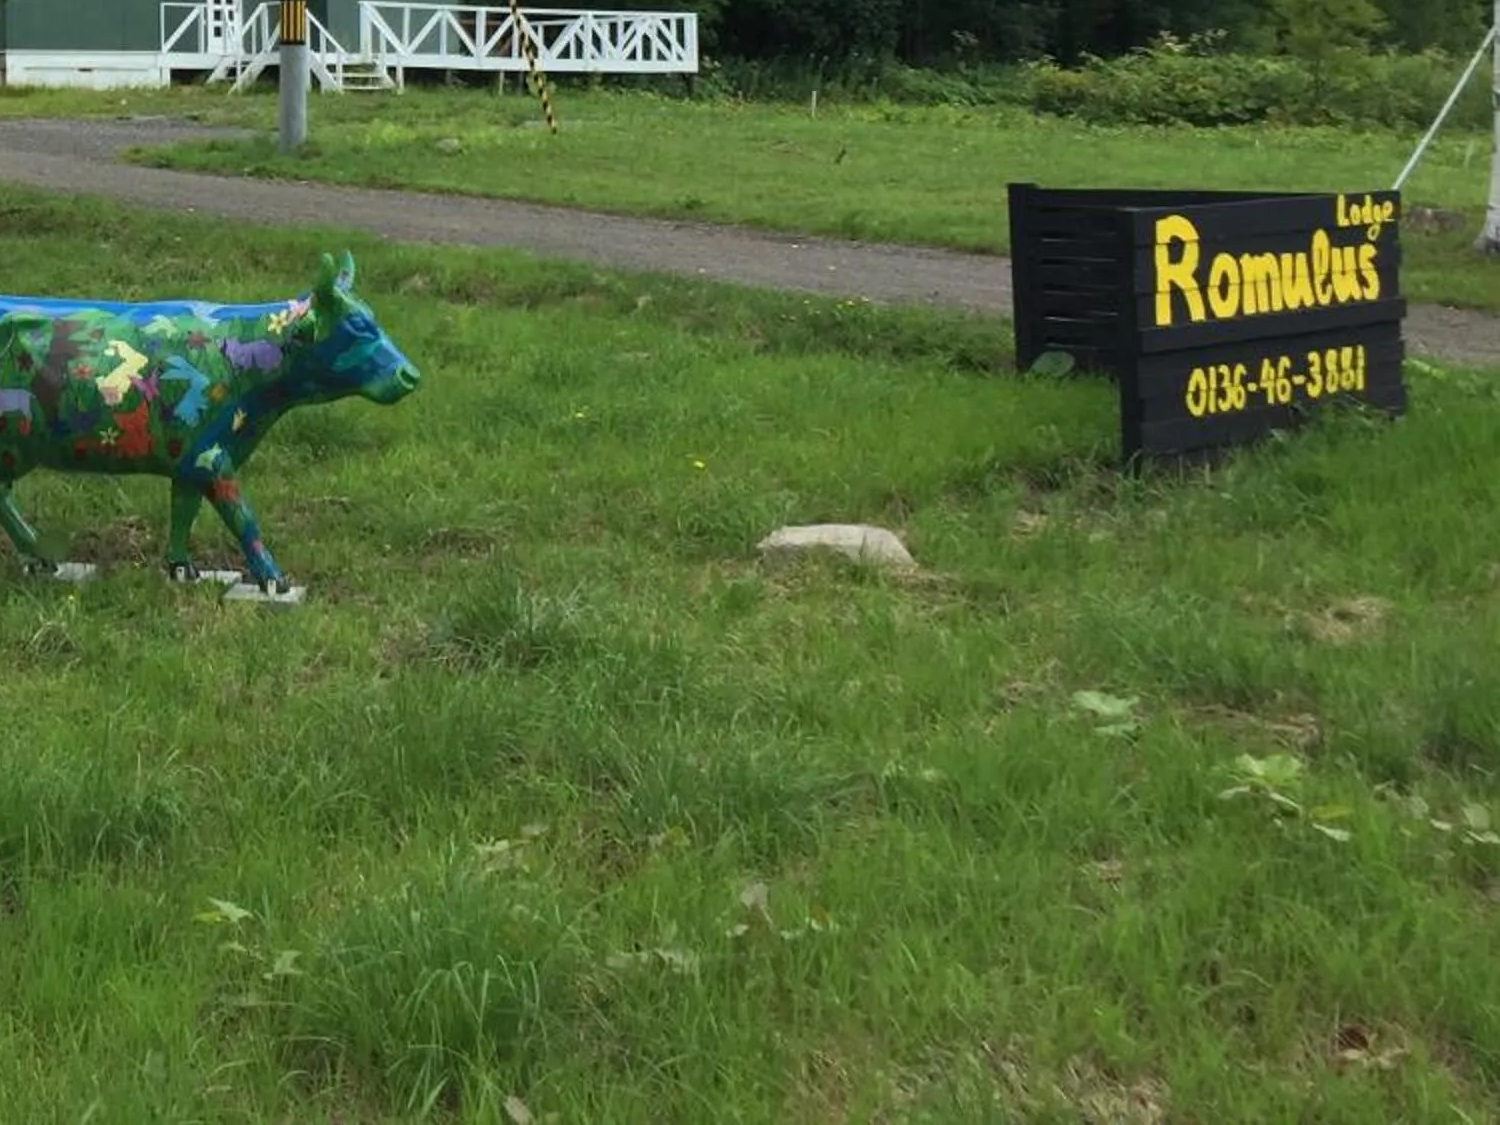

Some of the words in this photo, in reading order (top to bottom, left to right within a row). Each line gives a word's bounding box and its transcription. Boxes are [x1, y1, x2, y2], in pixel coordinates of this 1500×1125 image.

[1337, 194, 1395, 241] Lodge
[1155, 215, 1380, 325] Romulus
[1186, 345, 1365, 417] 0136-46-3881
